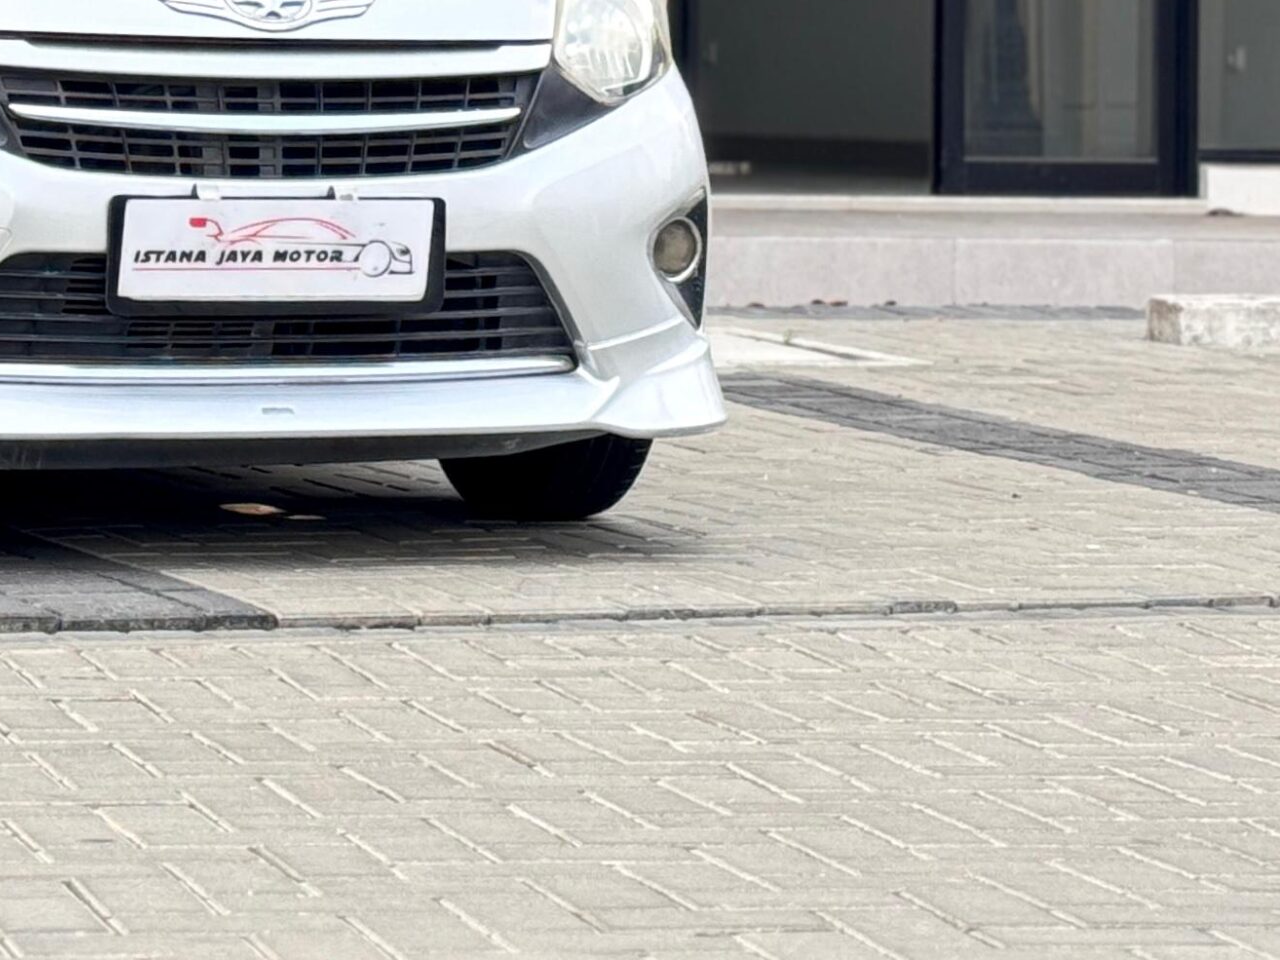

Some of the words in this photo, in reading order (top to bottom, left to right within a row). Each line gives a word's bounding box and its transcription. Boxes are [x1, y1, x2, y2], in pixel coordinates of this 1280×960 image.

[133, 249, 207, 264] ISTANA
[215, 249, 264, 266] JAYA
[272, 249, 344, 263] MOTOR
